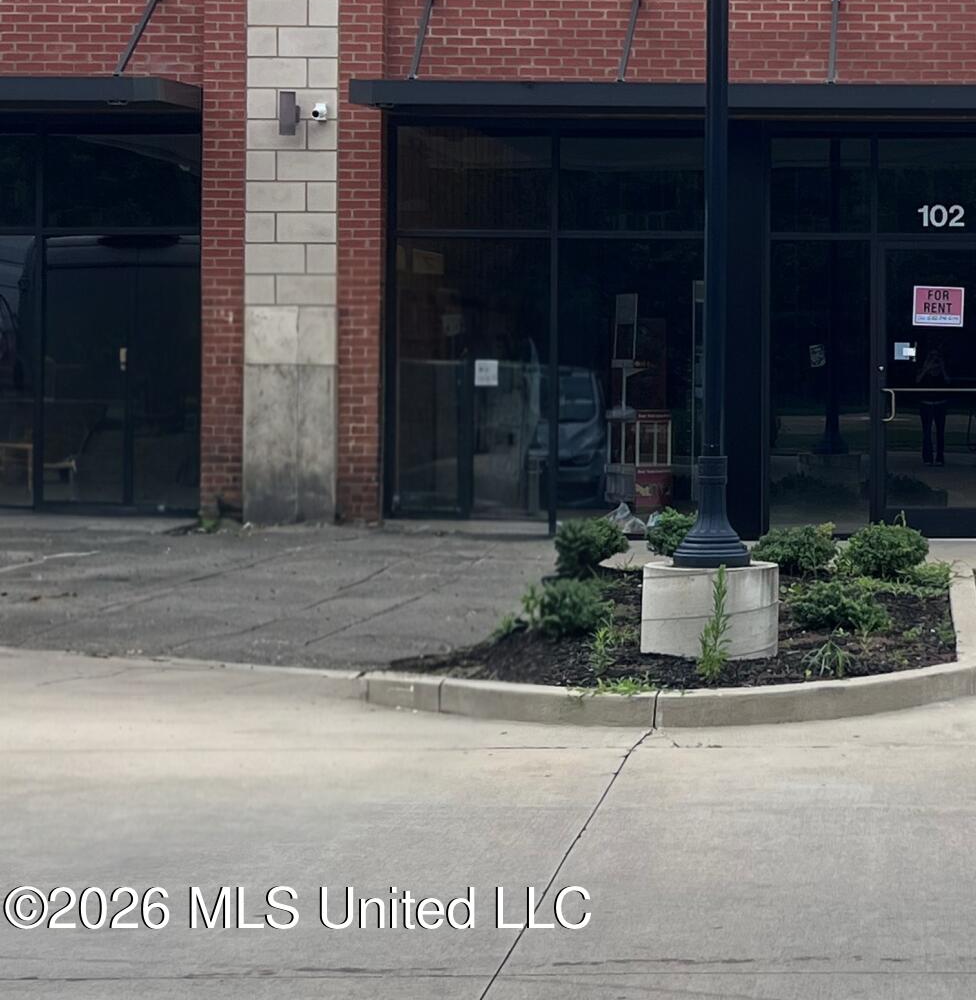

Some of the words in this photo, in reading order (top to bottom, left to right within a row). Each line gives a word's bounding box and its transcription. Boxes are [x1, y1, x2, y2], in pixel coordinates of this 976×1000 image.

[917, 204, 965, 227] 102
[927, 290, 950, 301] FOR
[923, 302, 952, 313] RENT
